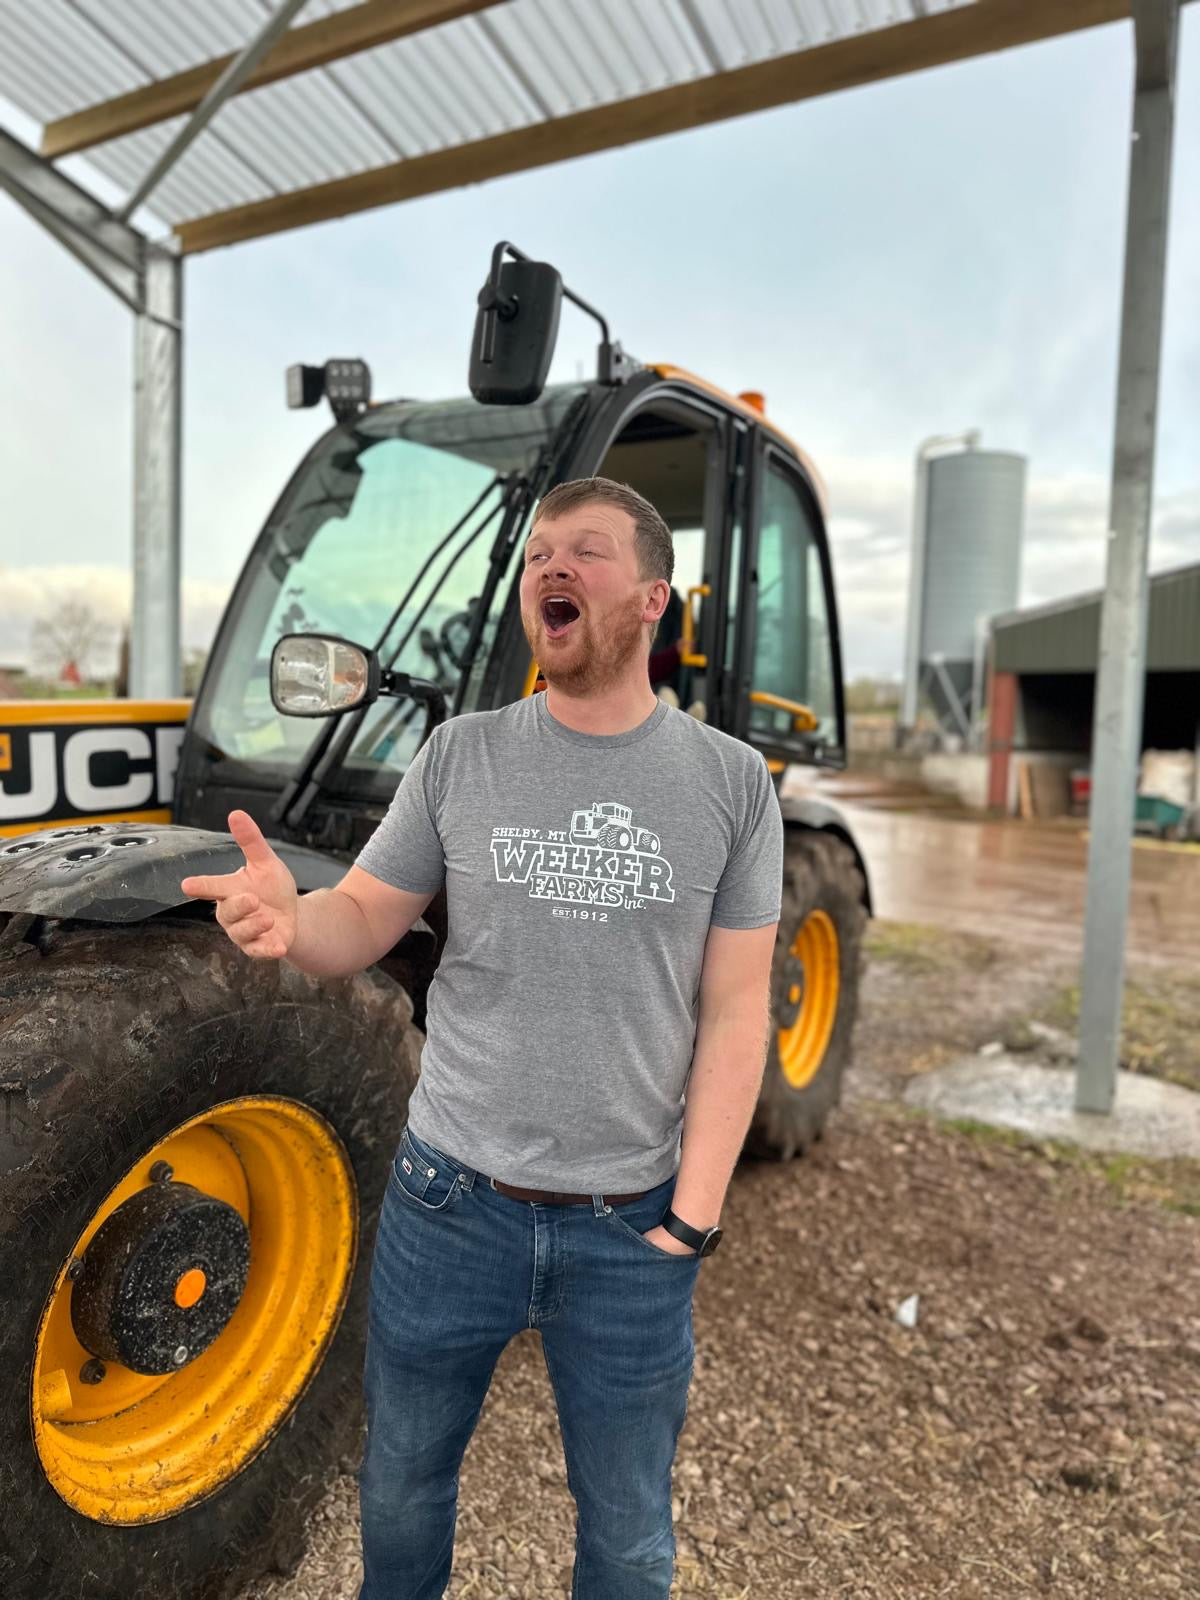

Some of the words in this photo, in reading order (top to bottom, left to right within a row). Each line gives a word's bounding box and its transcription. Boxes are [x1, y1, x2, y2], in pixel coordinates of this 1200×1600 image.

[492, 827, 543, 840] SHELBY,
[547, 830, 567, 841] MT
[490, 838, 675, 903] WELKER
[529, 873, 624, 907] FARMS
[624, 896, 647, 910] inc.
